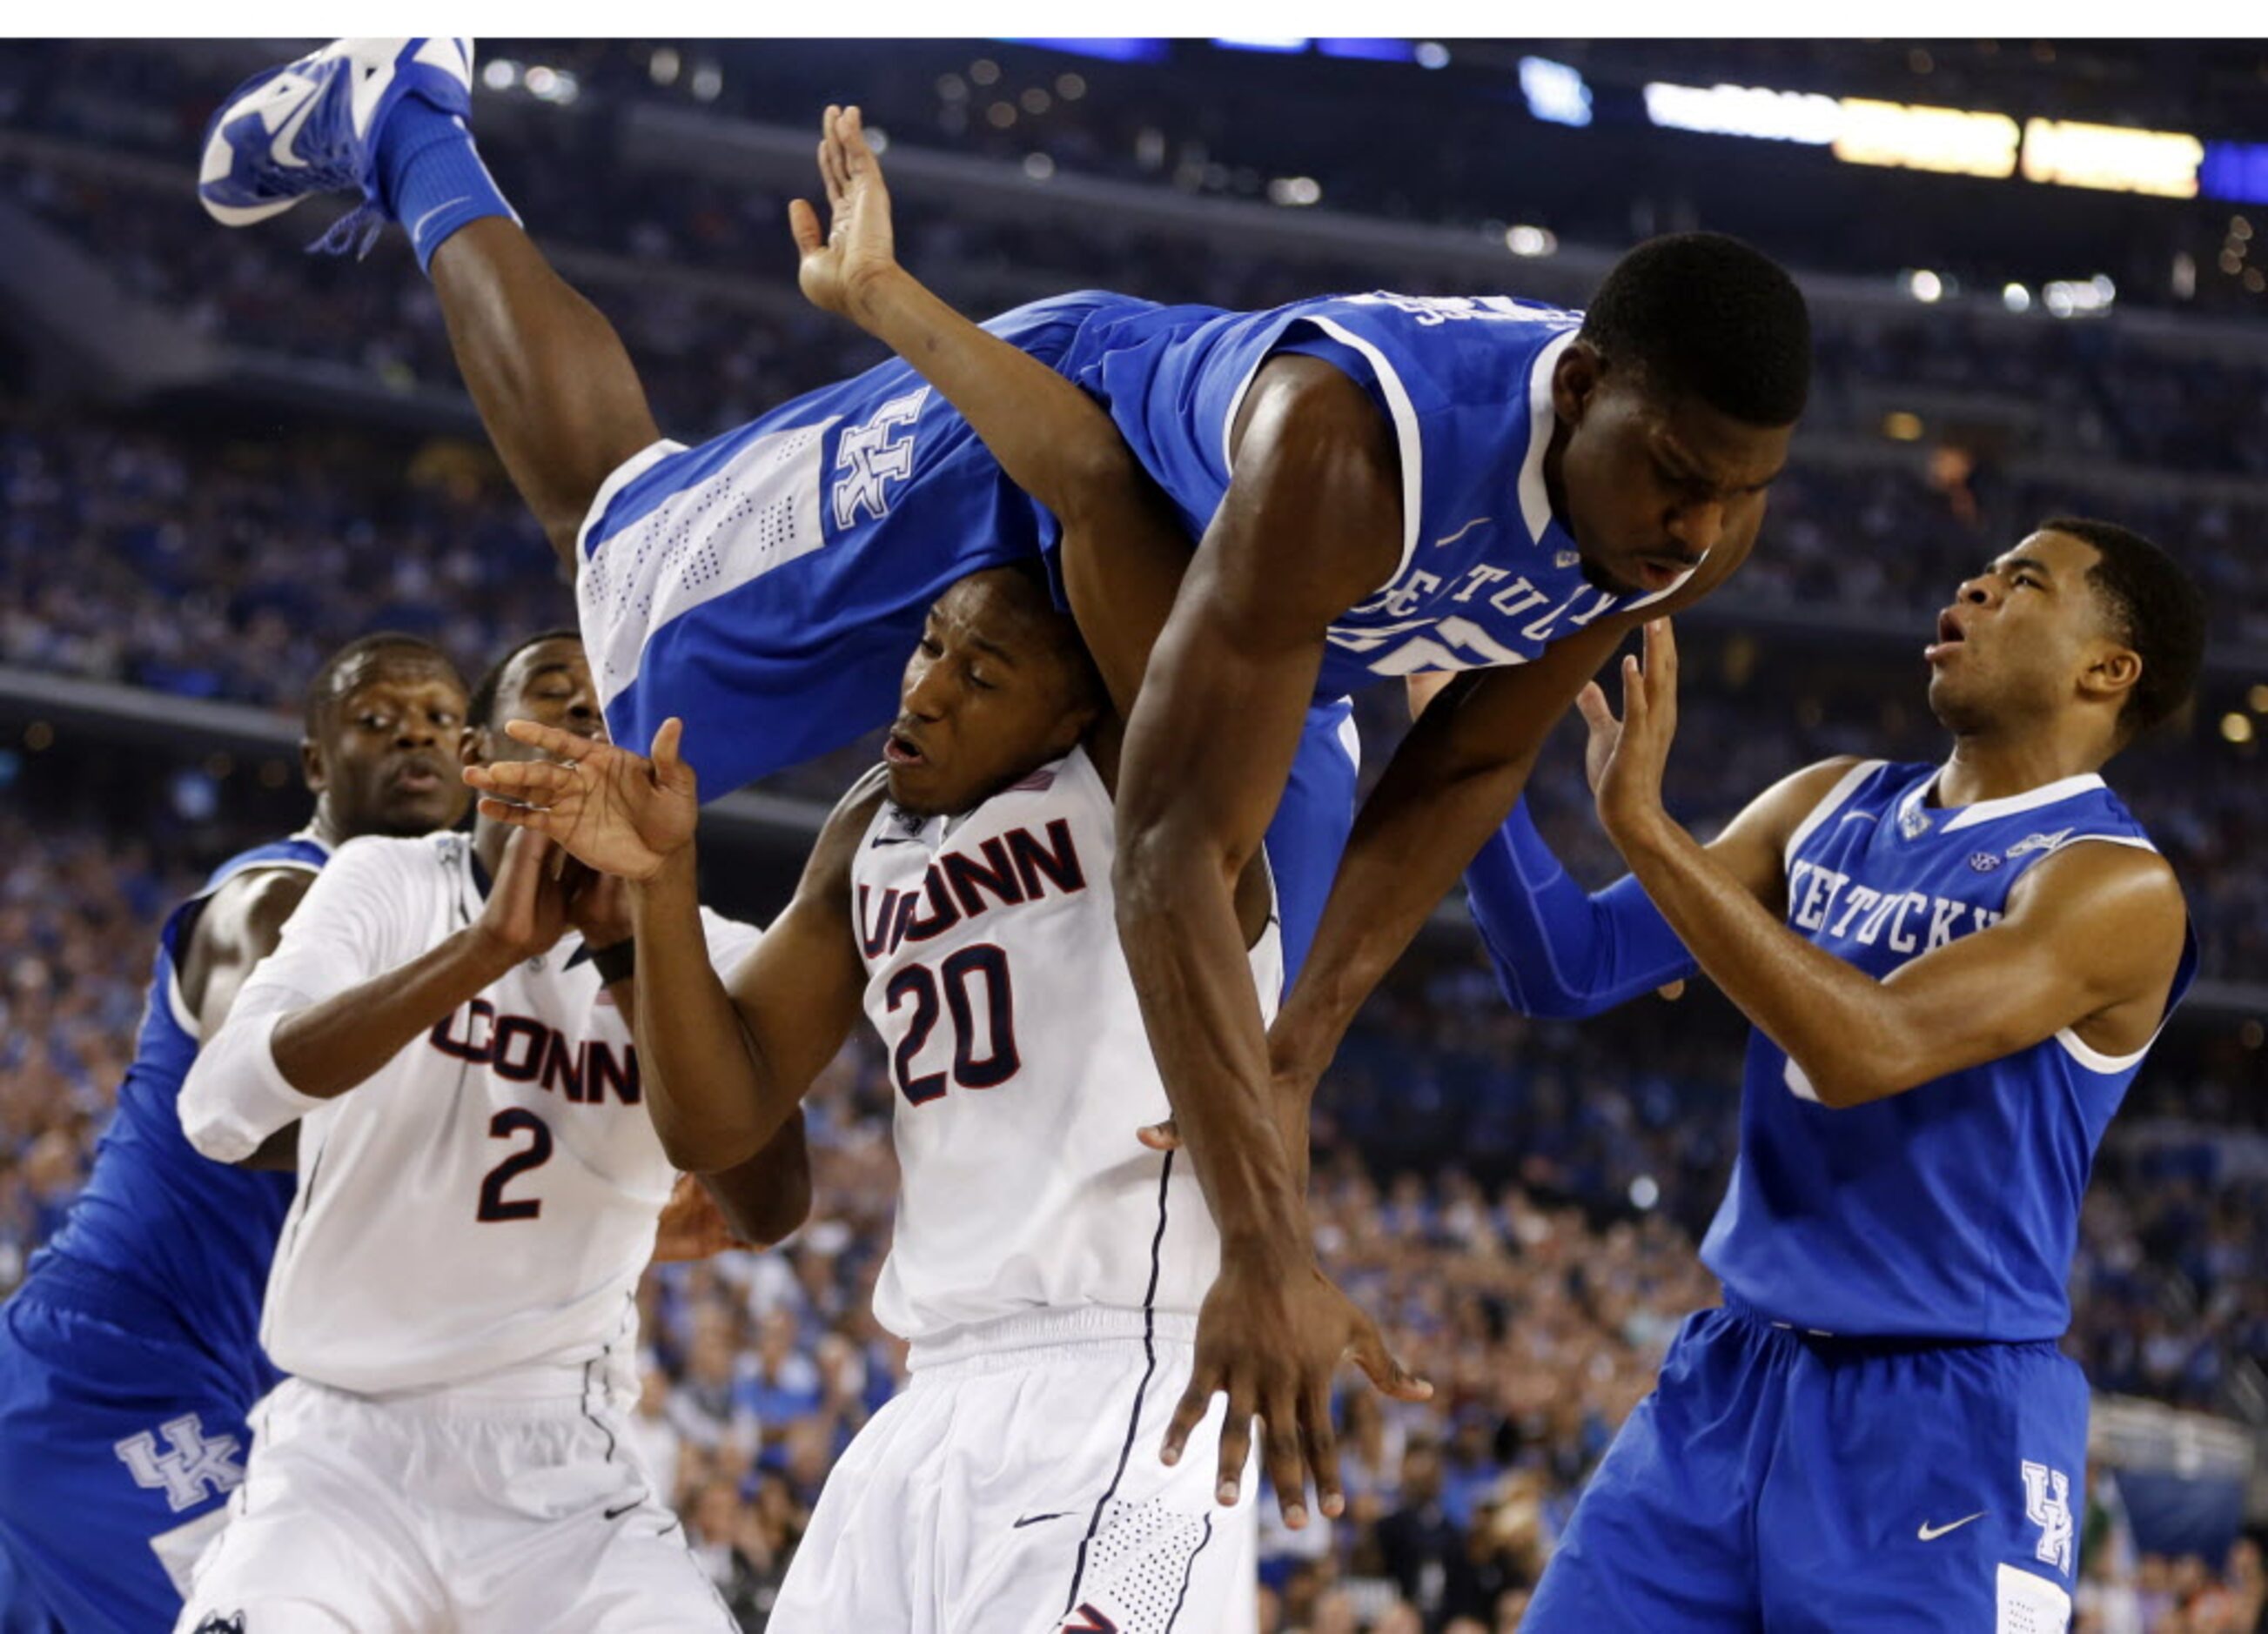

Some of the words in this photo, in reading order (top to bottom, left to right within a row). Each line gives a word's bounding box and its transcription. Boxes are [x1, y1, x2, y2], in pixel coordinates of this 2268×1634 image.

[885, 943, 1022, 1108] 20
[475, 1107, 554, 1222] 2
[113, 1411, 247, 1513] UK
[2022, 1458, 2073, 1579] UK
